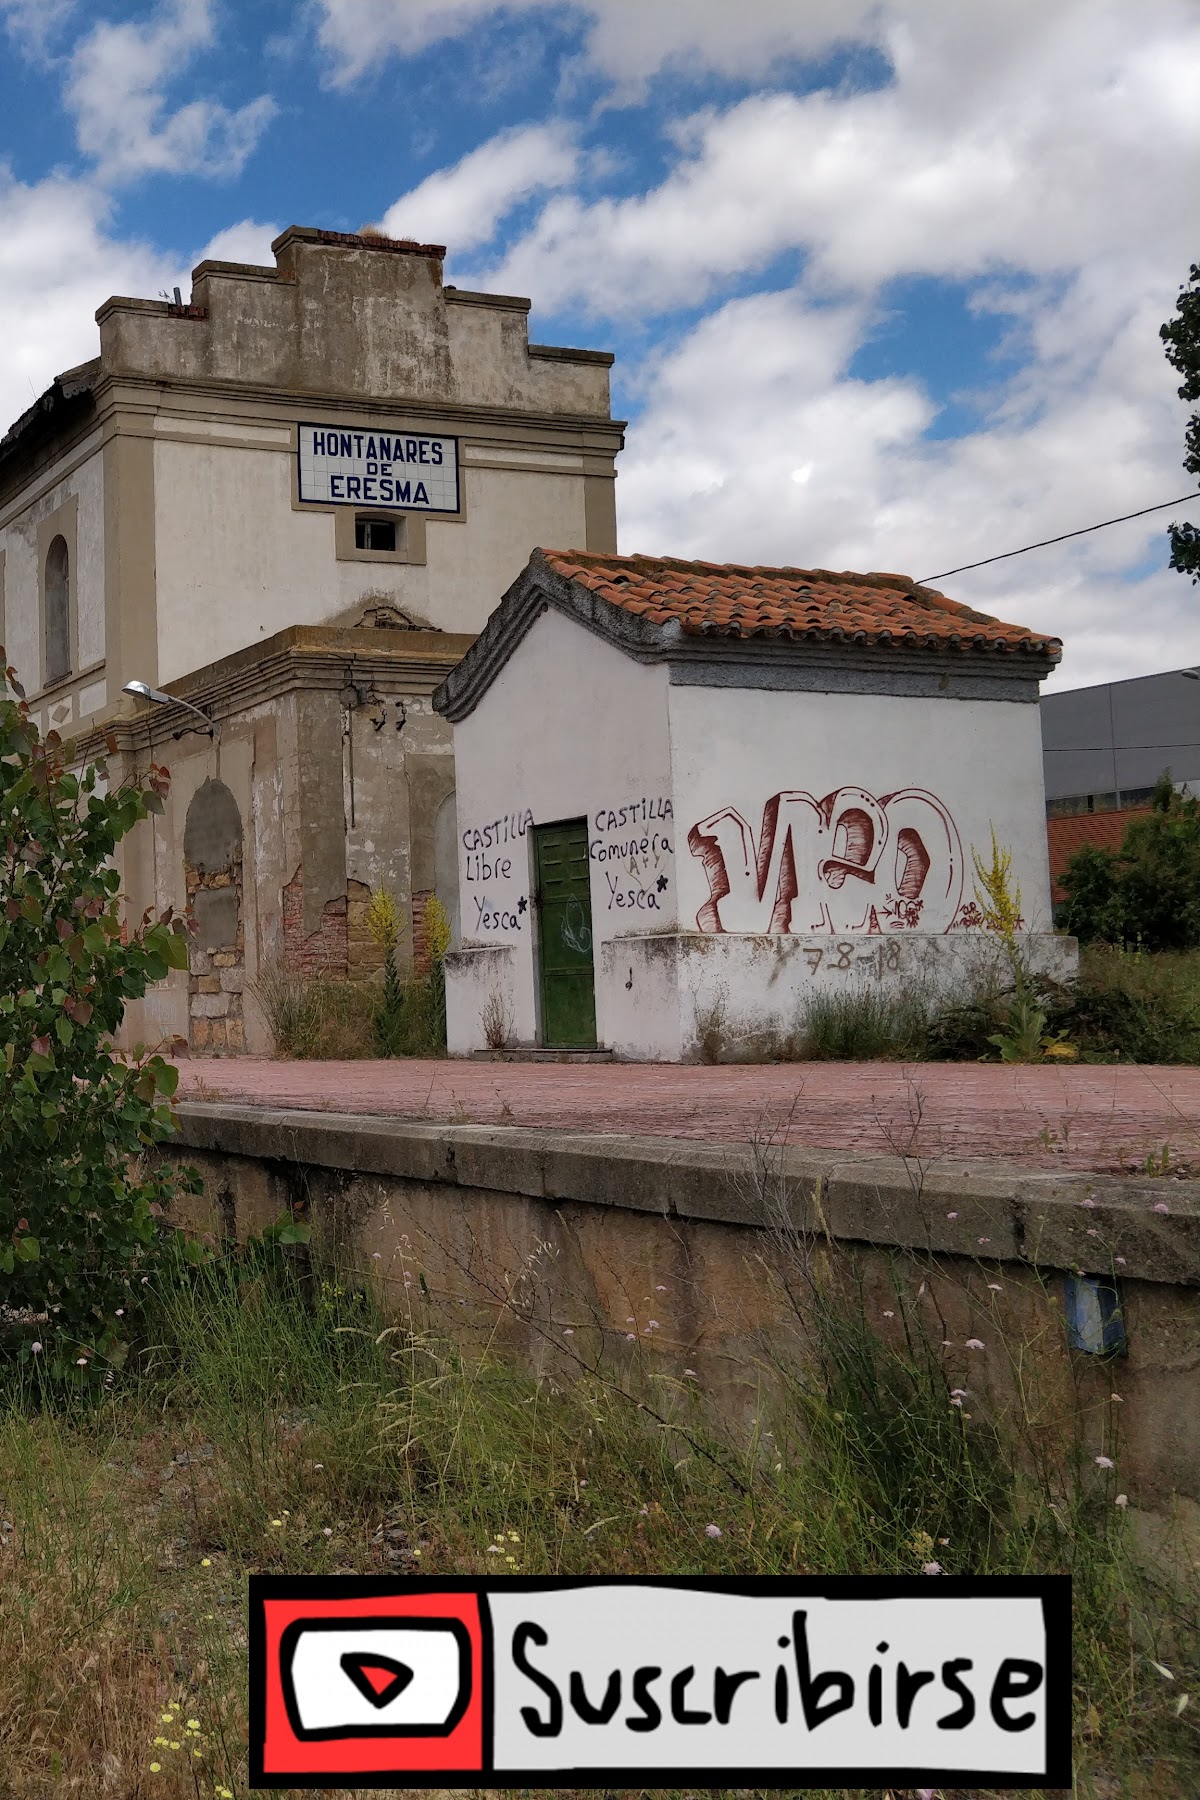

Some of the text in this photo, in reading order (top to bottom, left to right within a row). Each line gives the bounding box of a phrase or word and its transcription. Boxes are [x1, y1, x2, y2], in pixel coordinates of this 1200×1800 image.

[313, 431, 443, 465] HONTANARES
[367, 462, 392, 476] DE
[330, 475, 430, 504] ERESMA
